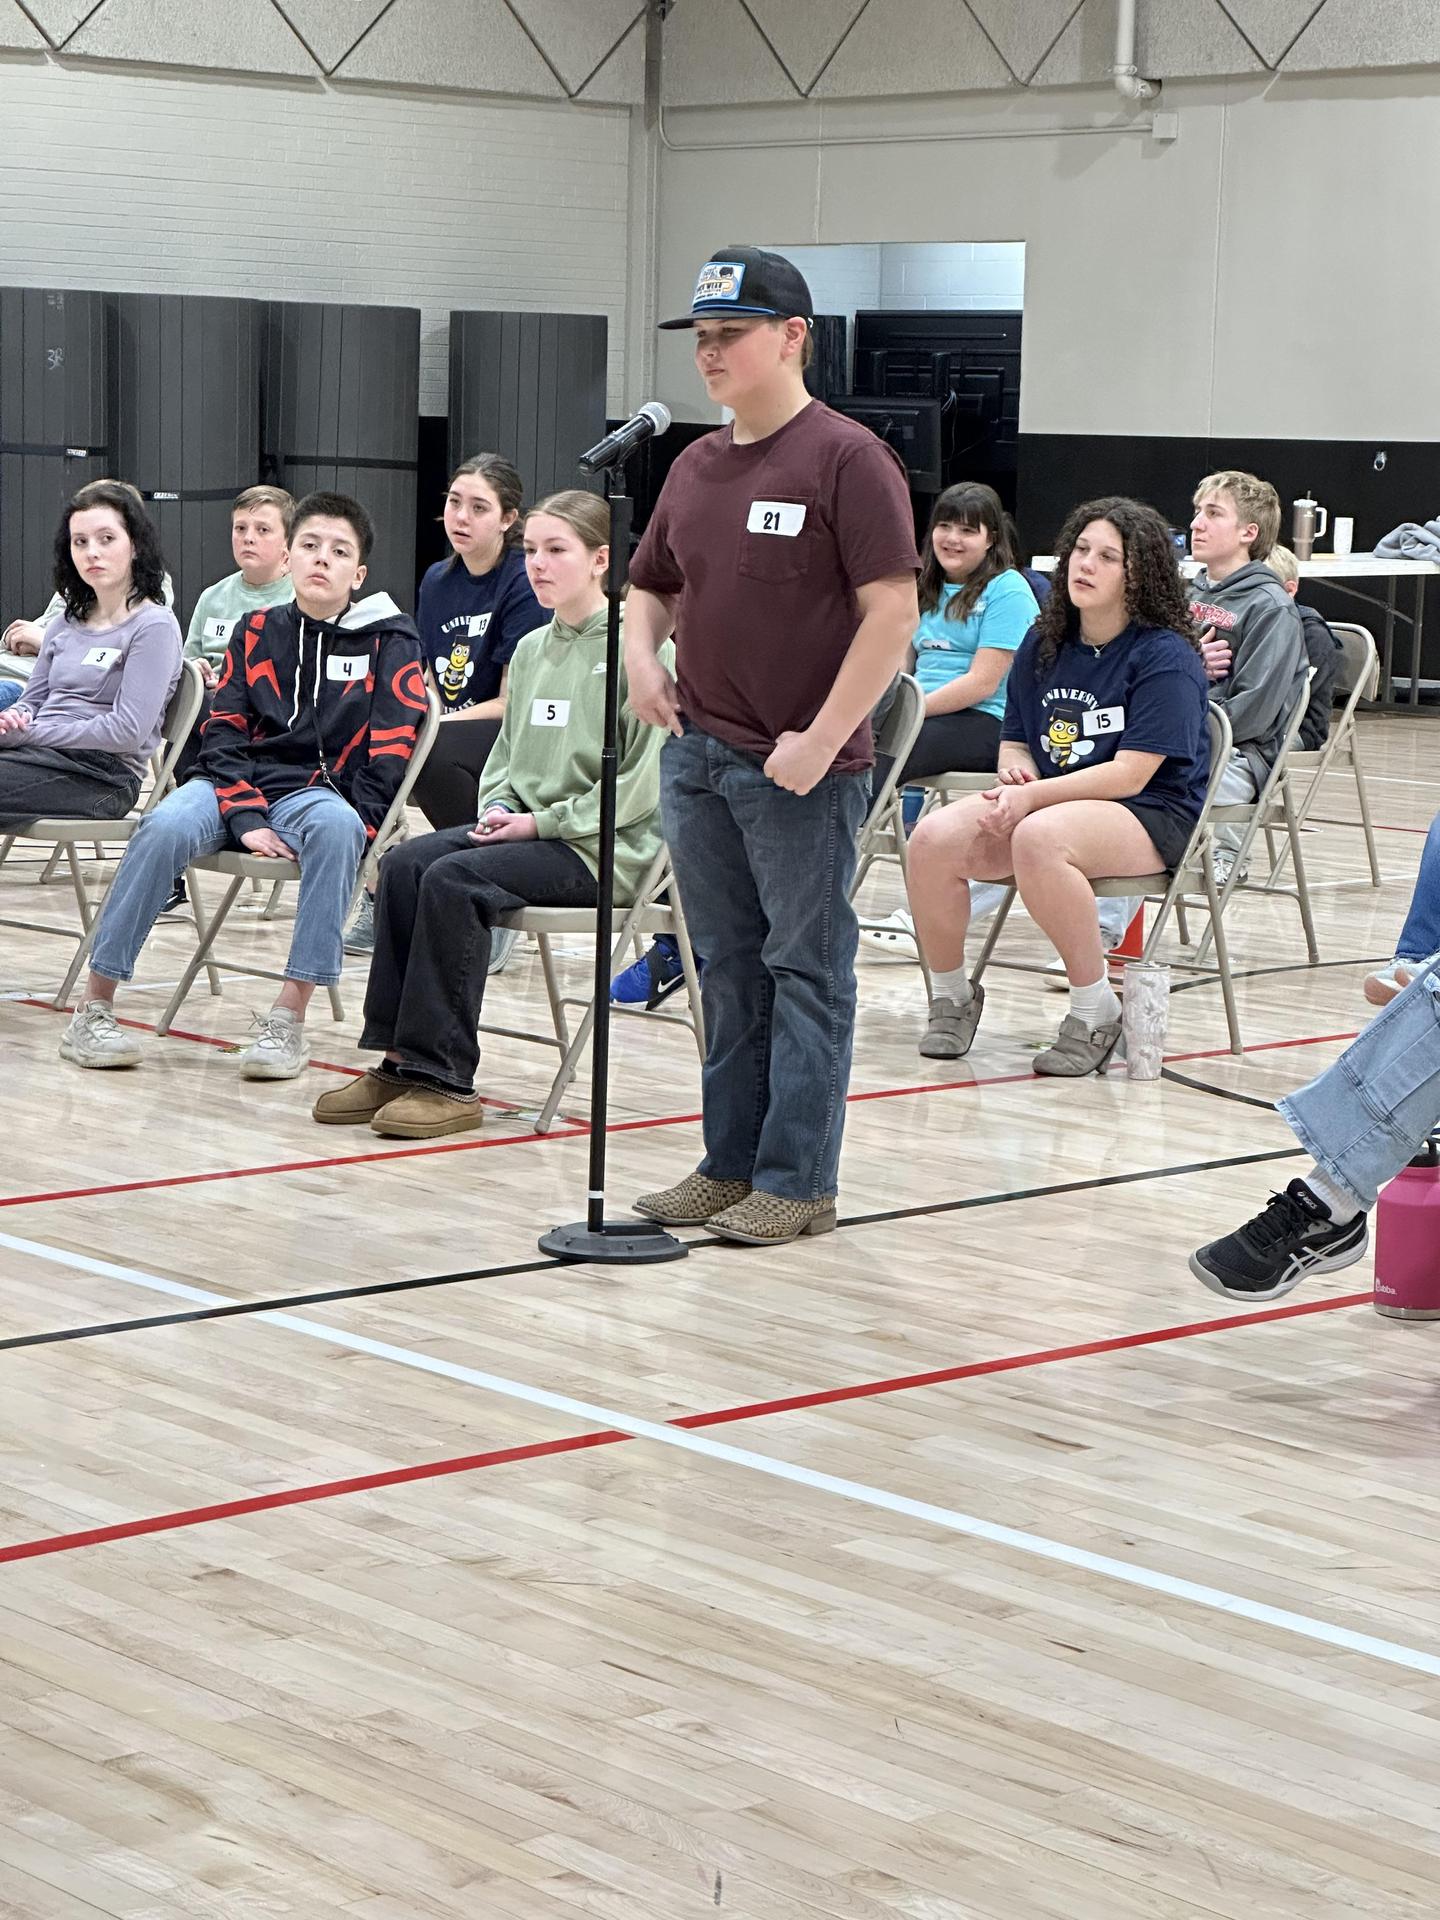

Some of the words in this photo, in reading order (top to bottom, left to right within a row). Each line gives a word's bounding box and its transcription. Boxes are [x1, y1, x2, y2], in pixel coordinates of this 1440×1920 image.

[763, 511, 780, 531] 21
[215, 624, 225, 636] 12
[96, 651, 106, 662] 3
[343, 662, 352, 676] 4
[546, 704, 556, 720] 5
[1096, 713, 1112, 729] 15
